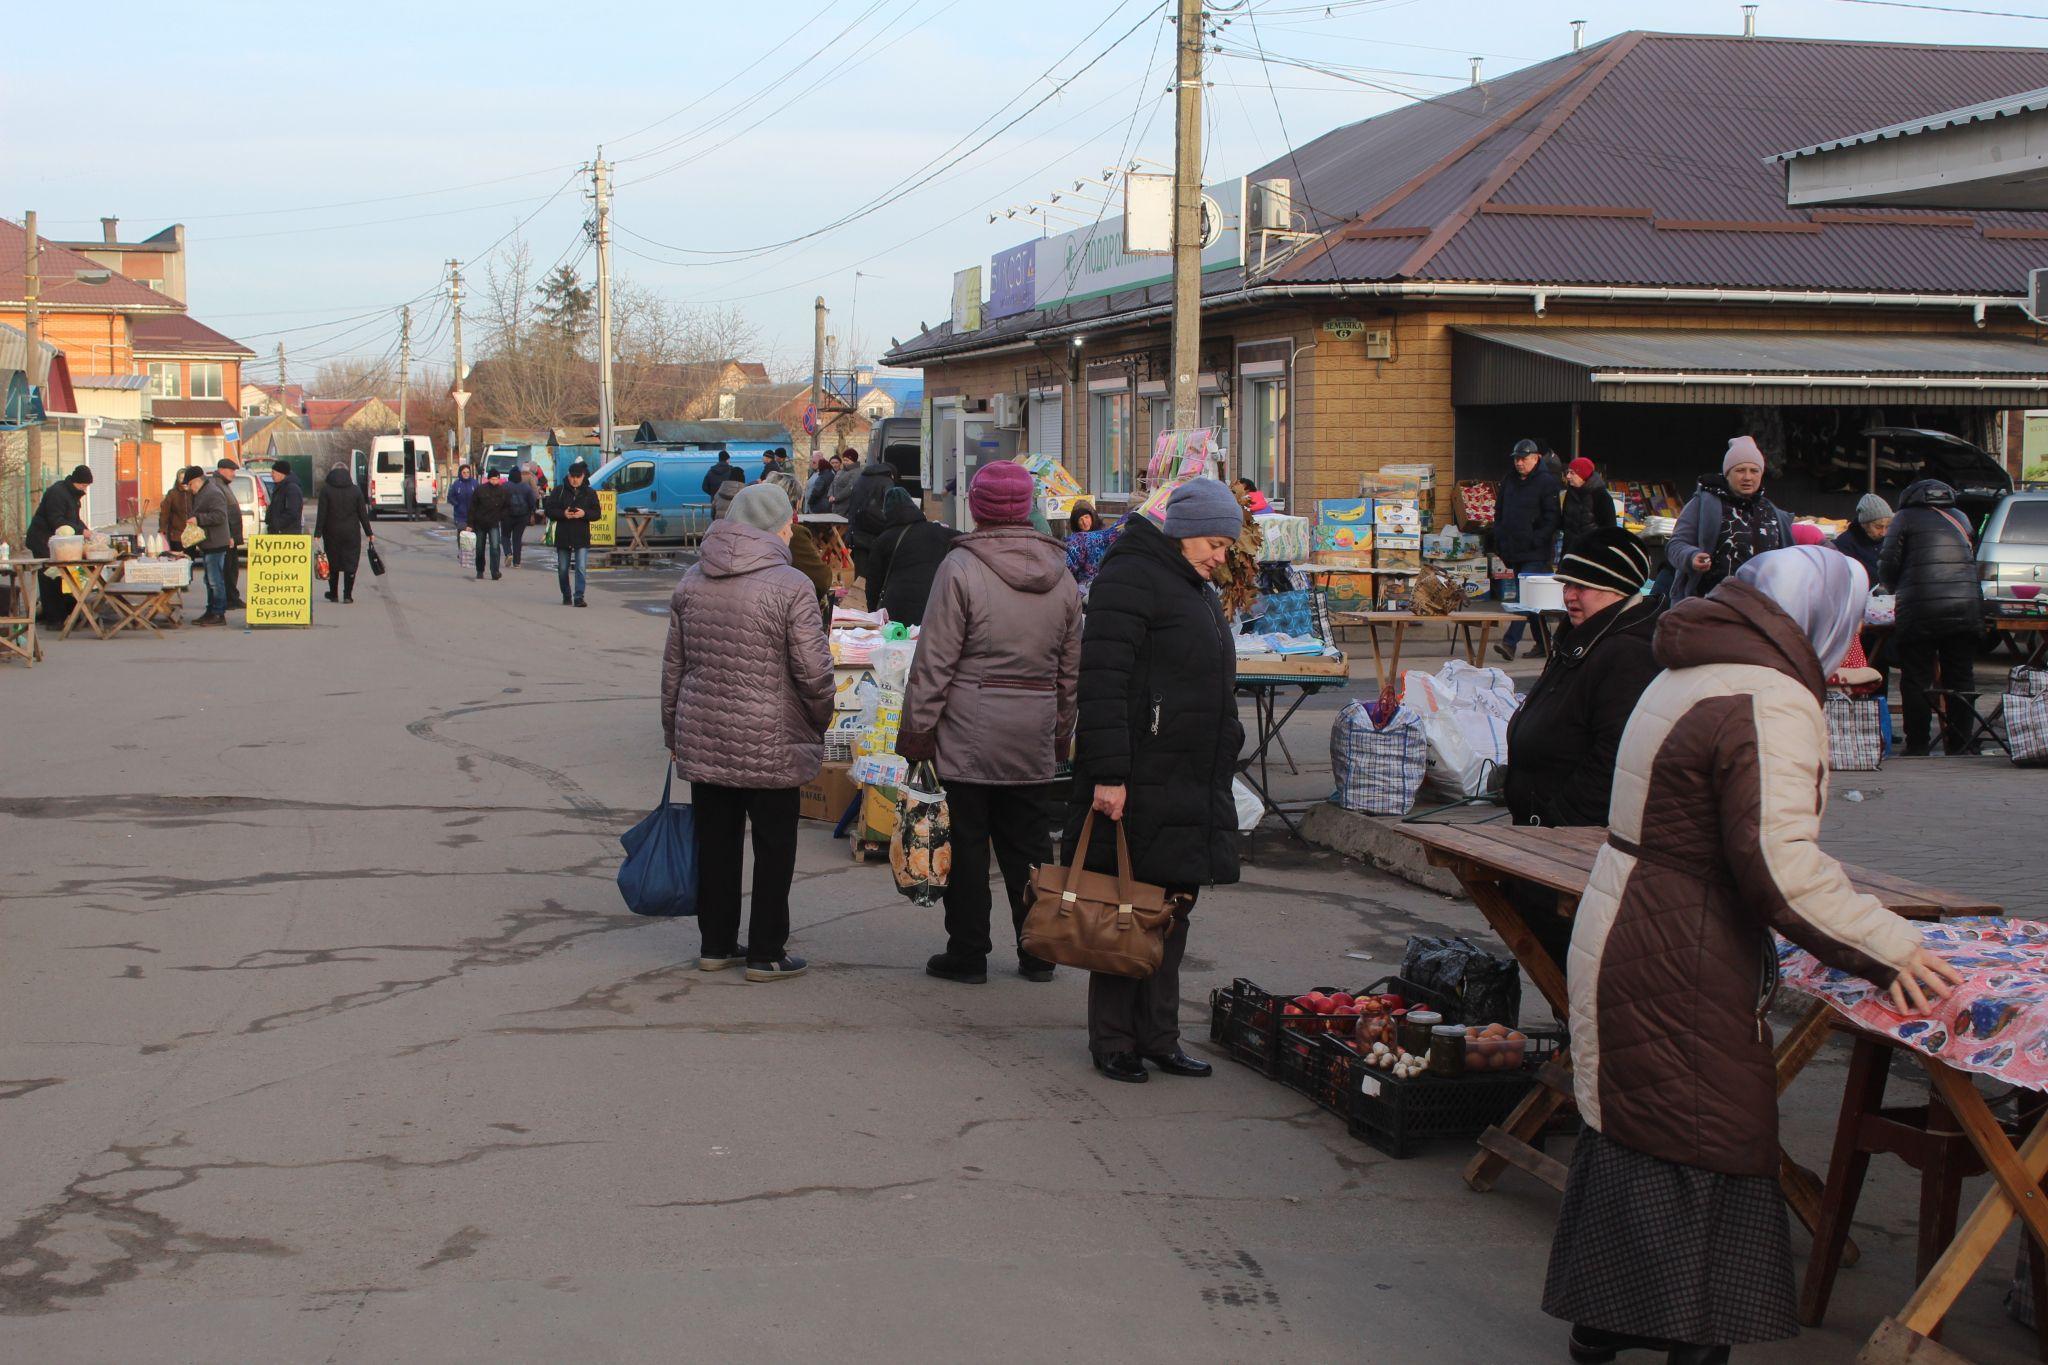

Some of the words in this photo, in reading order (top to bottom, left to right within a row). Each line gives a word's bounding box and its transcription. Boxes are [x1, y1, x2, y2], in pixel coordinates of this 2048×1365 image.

[1085, 232, 1152, 275] ПОДОРО
[255, 538, 306, 552] Куплю
[251, 554, 307, 566] дорого
[259, 570, 299, 583] Горіхи
[253, 583, 304, 595] Зернята
[250, 595, 307, 606] Квасолю
[255, 607, 301, 620] Бузину
